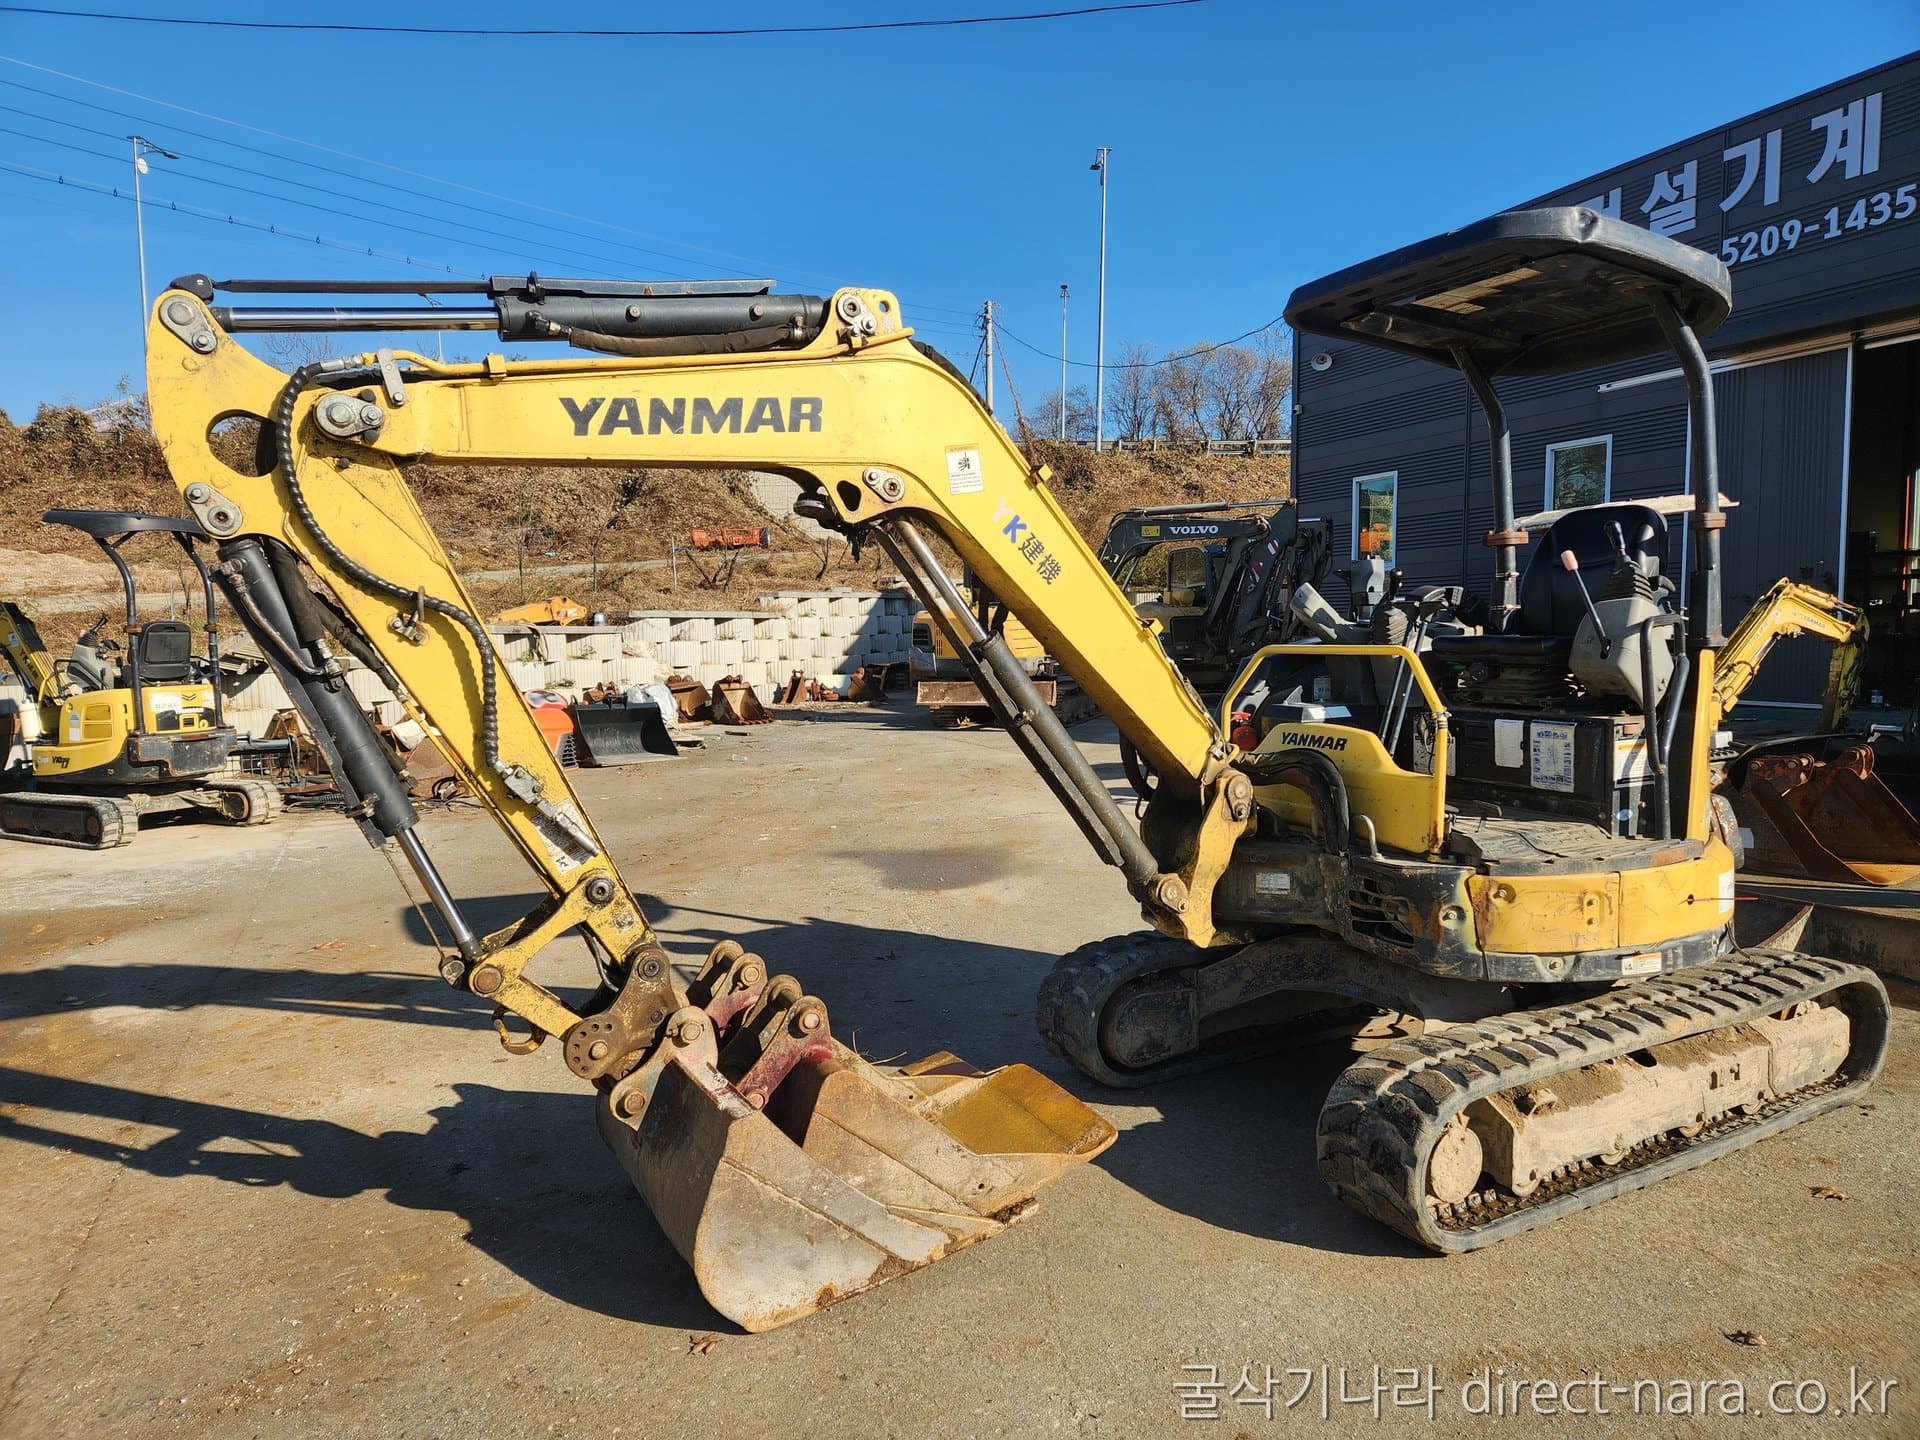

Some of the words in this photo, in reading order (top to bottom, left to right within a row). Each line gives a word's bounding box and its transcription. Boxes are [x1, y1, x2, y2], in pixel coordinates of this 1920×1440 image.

[559, 396, 823, 436] YANMAR
[1169, 525, 1219, 535] VOLVO
[1281, 731, 1348, 751] YANMAR
